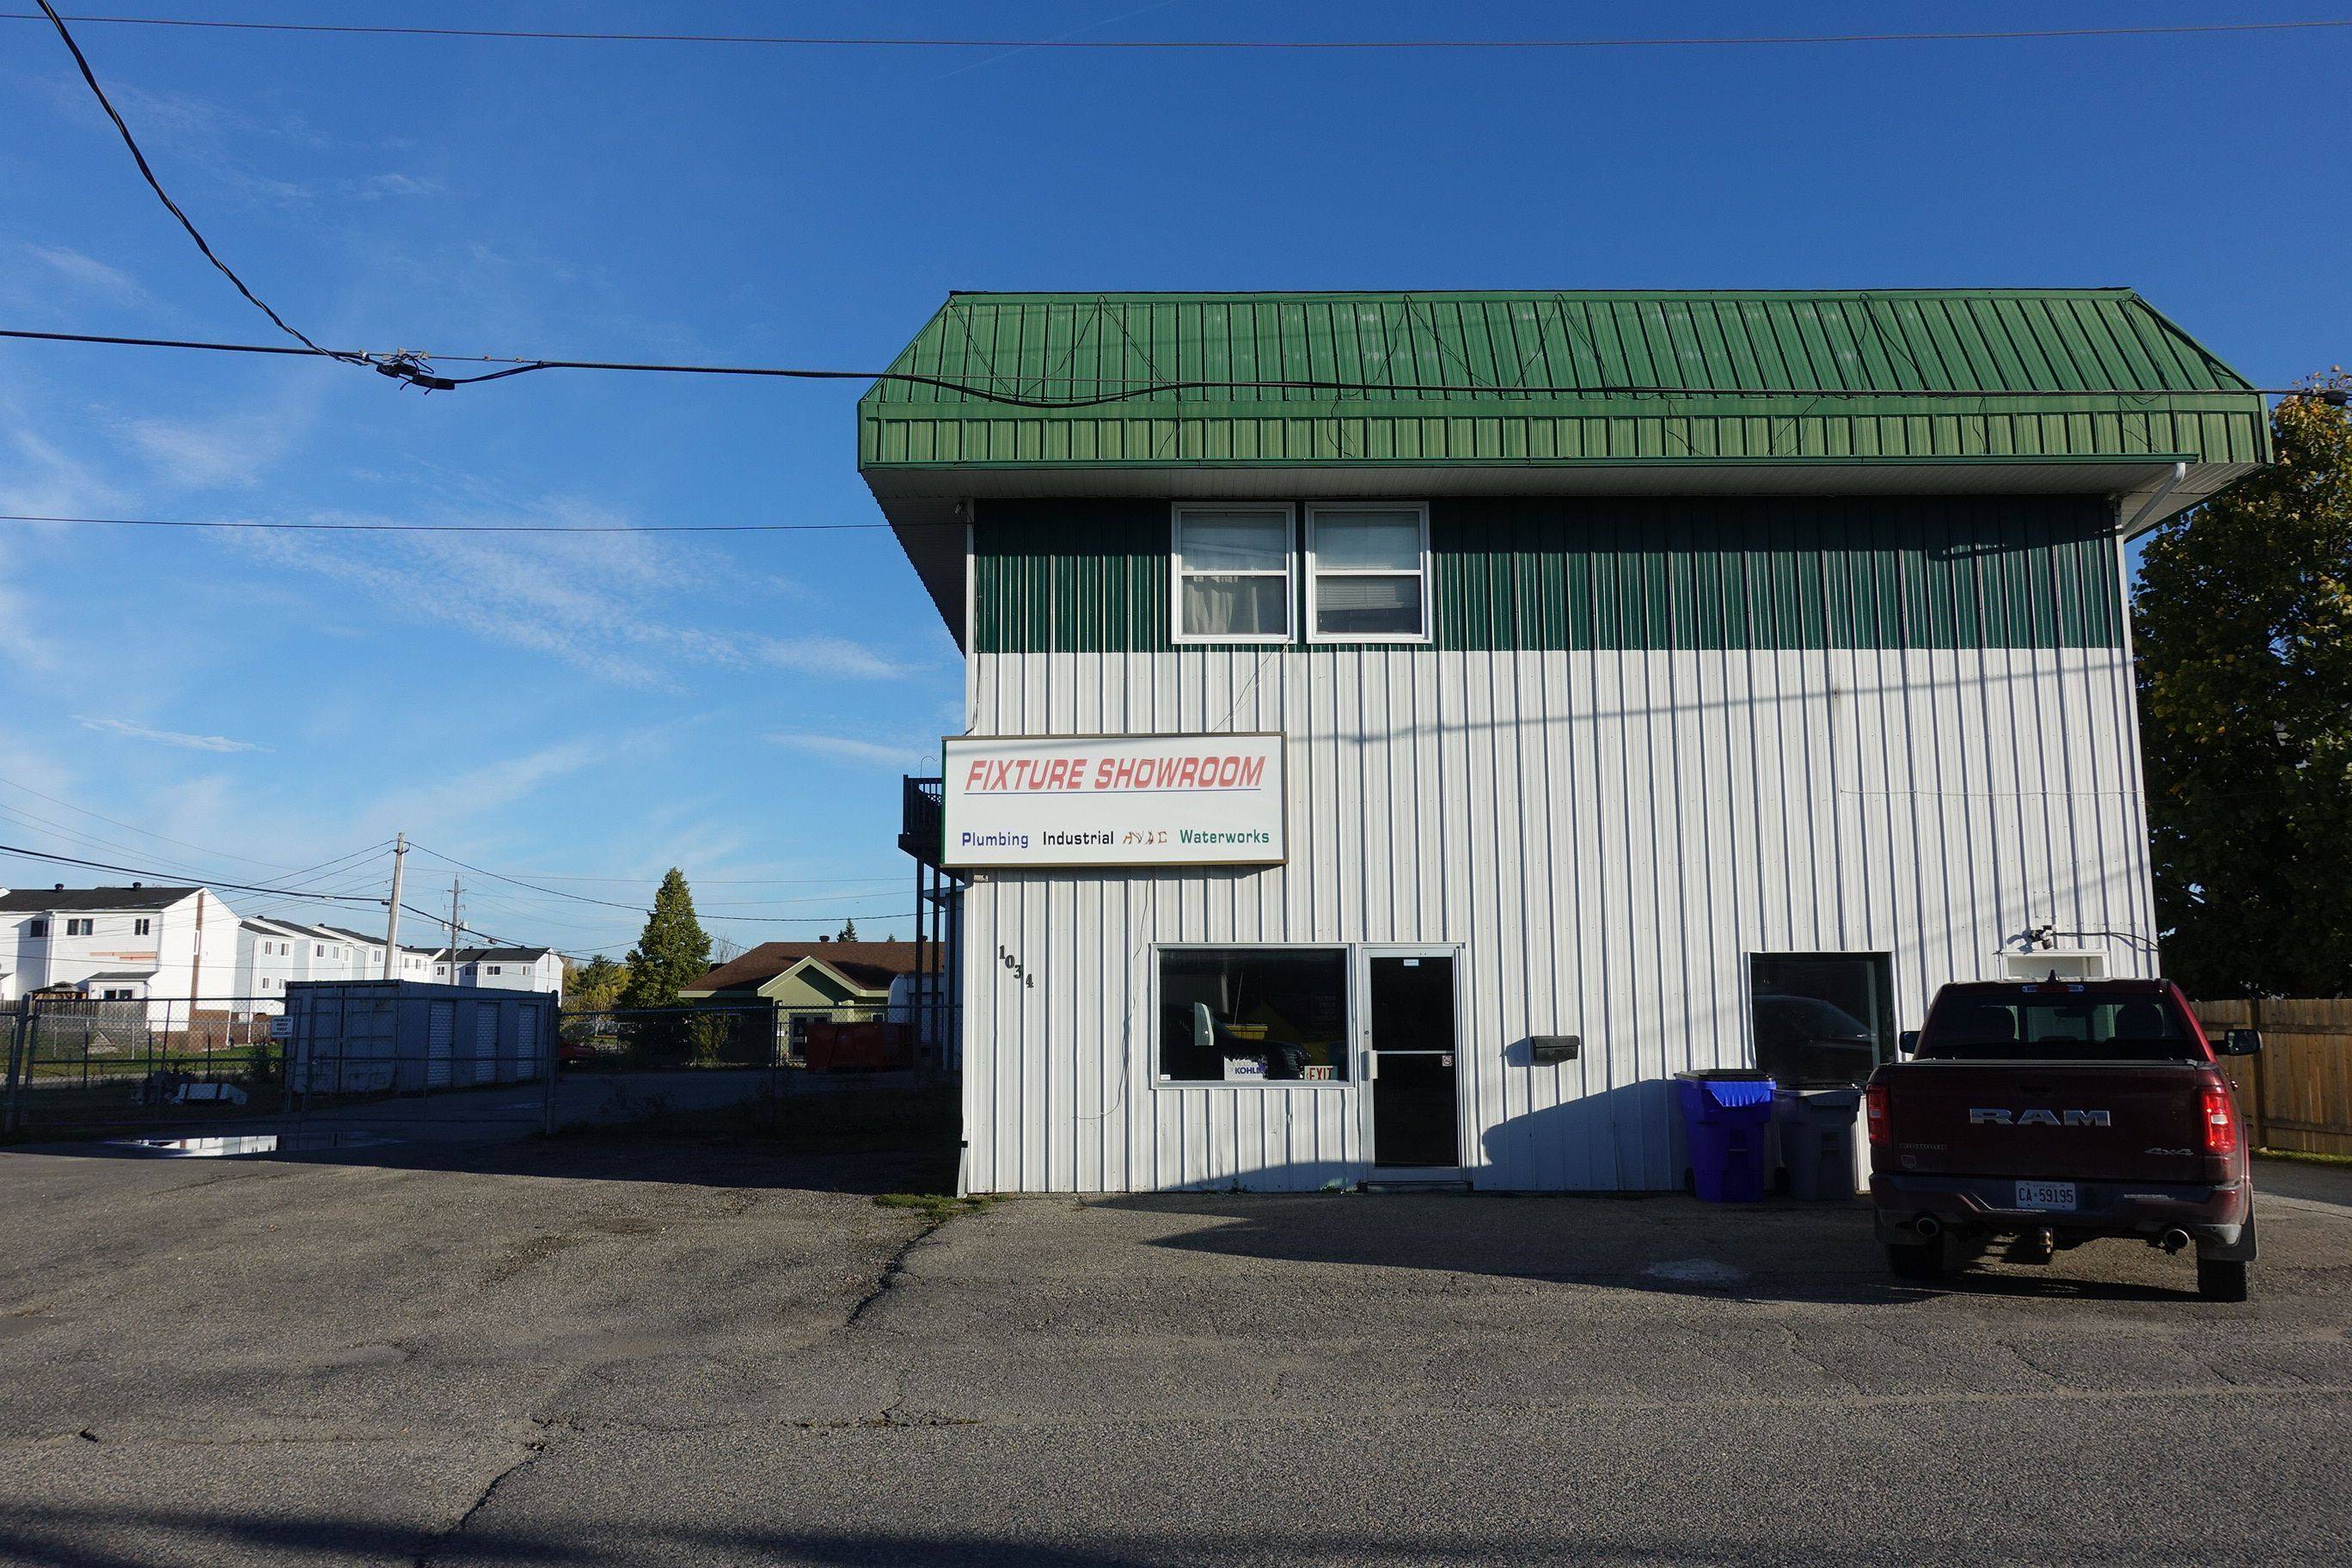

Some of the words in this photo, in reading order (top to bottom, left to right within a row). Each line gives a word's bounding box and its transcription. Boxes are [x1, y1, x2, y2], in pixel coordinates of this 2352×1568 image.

[965, 759, 1087, 791] FIXTURE
[1094, 756, 1266, 789] SHOWROOM
[961, 831, 1029, 848] Plumbing
[1043, 830, 1114, 846] Industrial
[1179, 829, 1271, 844] Waterworks
[999, 945, 1034, 989] 1034
[1309, 1067, 1333, 1081] EXIT
[1969, 1108, 2111, 1127] RAM
